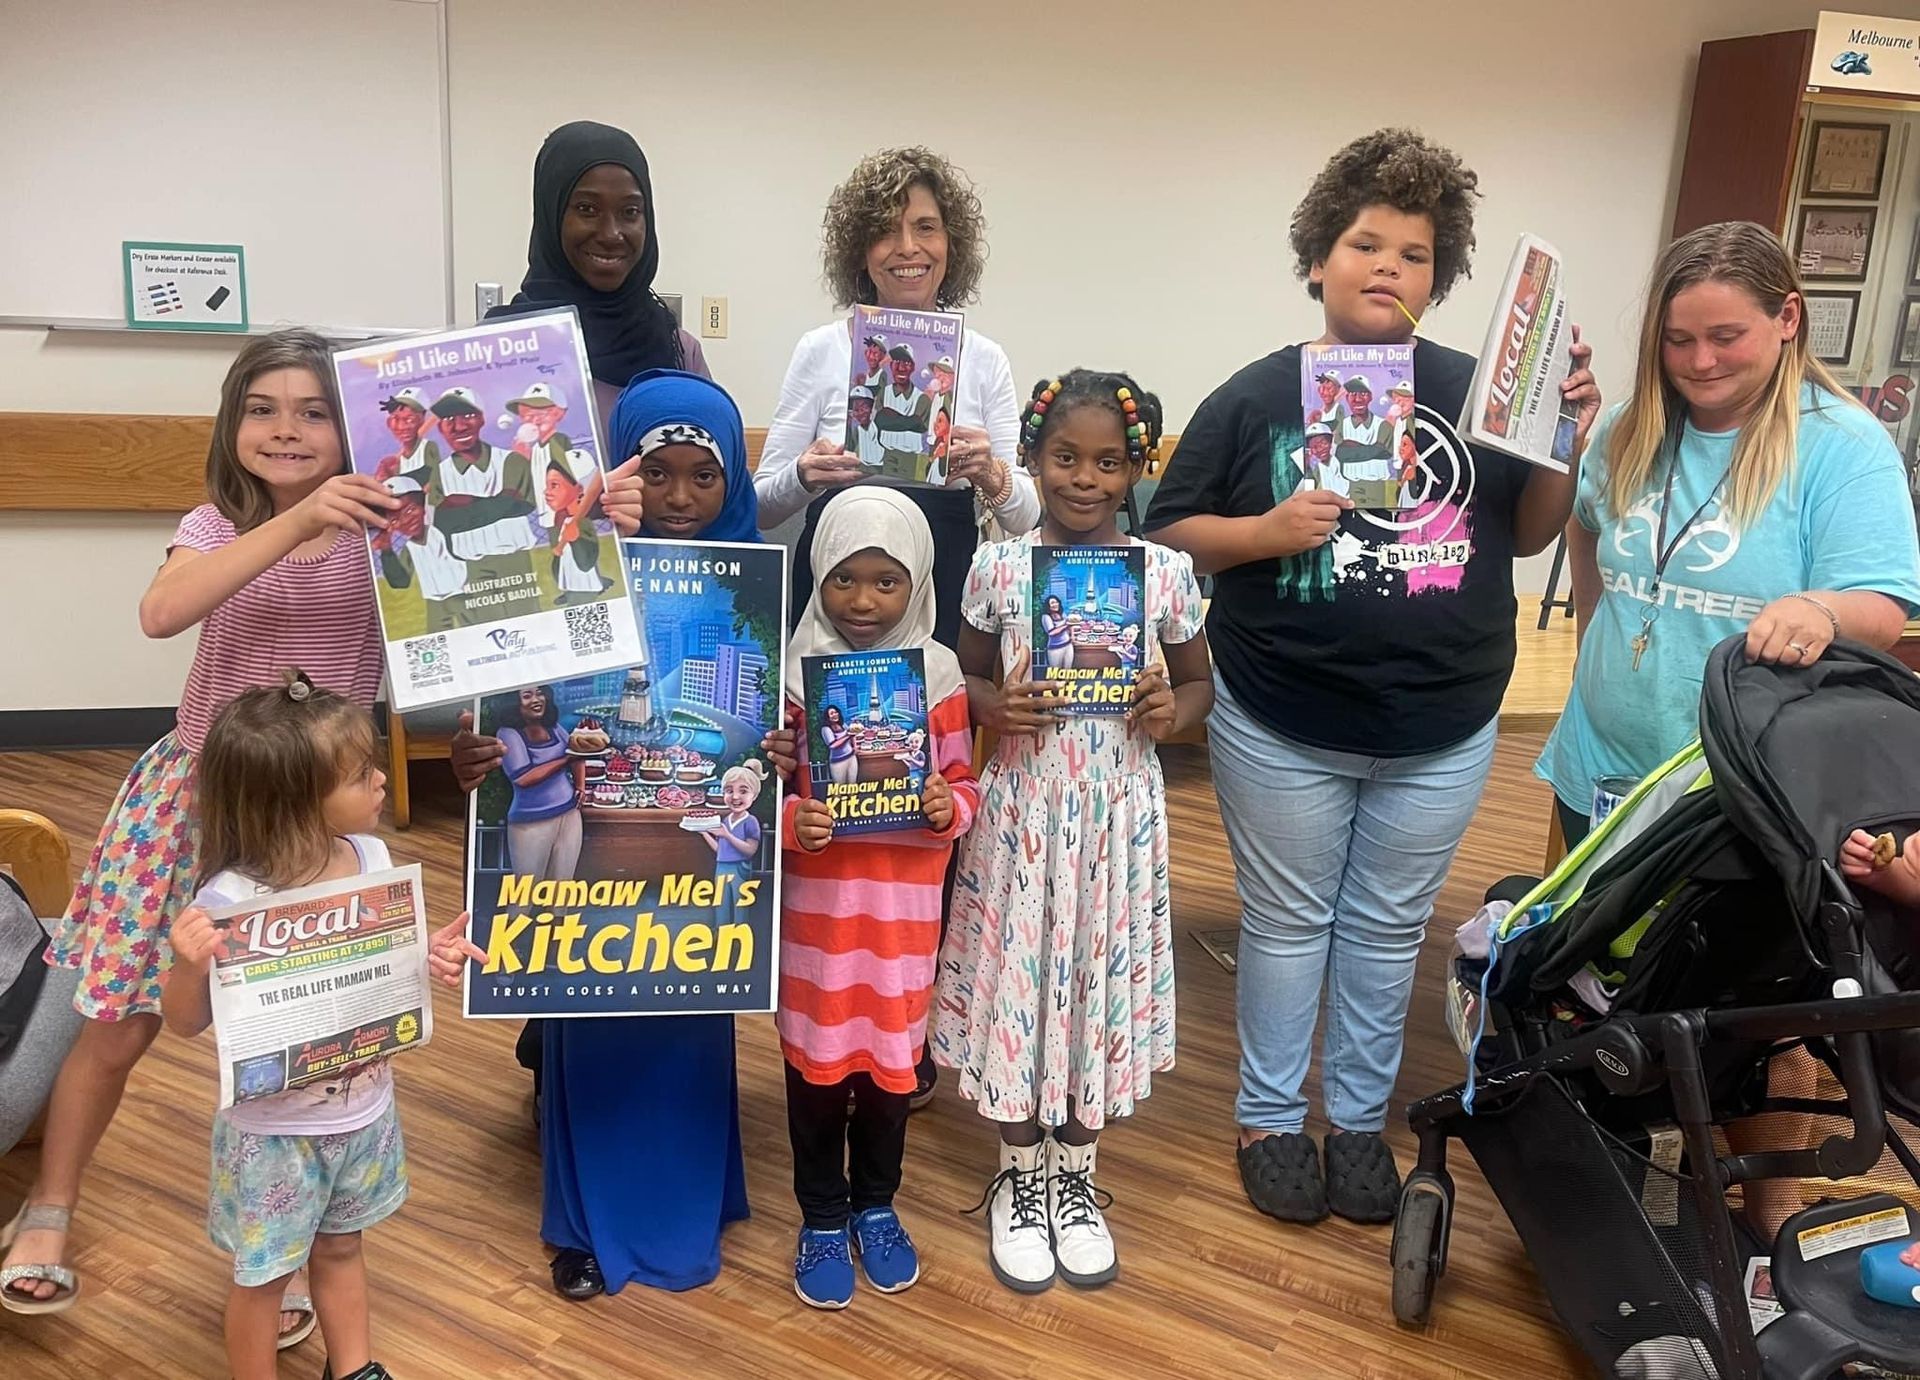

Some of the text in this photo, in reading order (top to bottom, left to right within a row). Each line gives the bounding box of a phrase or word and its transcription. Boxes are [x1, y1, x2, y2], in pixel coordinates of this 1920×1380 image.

[1848, 29, 1913, 49] Melbourne
[132, 253, 143, 262] Dry
[145, 265, 153, 273] for
[154, 266, 178, 274] checkout
[865, 311, 887, 326] Just
[889, 313, 912, 329] Like
[914, 317, 931, 335] My
[933, 319, 956, 335] Dad
[1546, 317, 1562, 356] MAMAW
[376, 331, 539, 379] Just Like My Dad
[1316, 348, 1410, 364] Just Like My Dad
[1490, 303, 1531, 407] Local
[1539, 356, 1551, 375] LIFE
[1534, 375, 1546, 397] REAL
[1528, 397, 1539, 415] THE
[649, 558, 741, 576] JOHNSON
[463, 571, 538, 594] ILLUSTRATED BY
[650, 580, 703, 595] NANN
[1600, 565, 1768, 621] EALTREE
[465, 586, 543, 610] NICOLAS BADILA
[822, 656, 902, 669] ELIZABETH JOHNSON
[838, 667, 866, 676] AUNTIE
[1045, 666, 1139, 680] Mamaw Mel's
[1042, 680, 1136, 704] tchen
[827, 776, 920, 797] Mamaw Mel's
[826, 792, 920, 820] Kitchen
[387, 882, 412, 901] FREE
[496, 873, 761, 908] Mamaw Mel's
[275, 899, 335, 918] BREVARD'S
[239, 894, 360, 957] Local
[481, 911, 754, 975] Kitchen
[245, 962, 279, 977] CARS
[281, 950, 338, 969] STARTING
[340, 945, 352, 956] AT
[258, 964, 391, 1006] THE REAL LIFE MAMAW MEL
[493, 983, 752, 997] TRUST GOES A LONG WAY
[294, 1042, 342, 1068] AURORA
[347, 1026, 391, 1052] ARMORY
[307, 1043, 381, 1073] BUY SELL TRADE
[1600, 1052, 1625, 1073] GRACO
